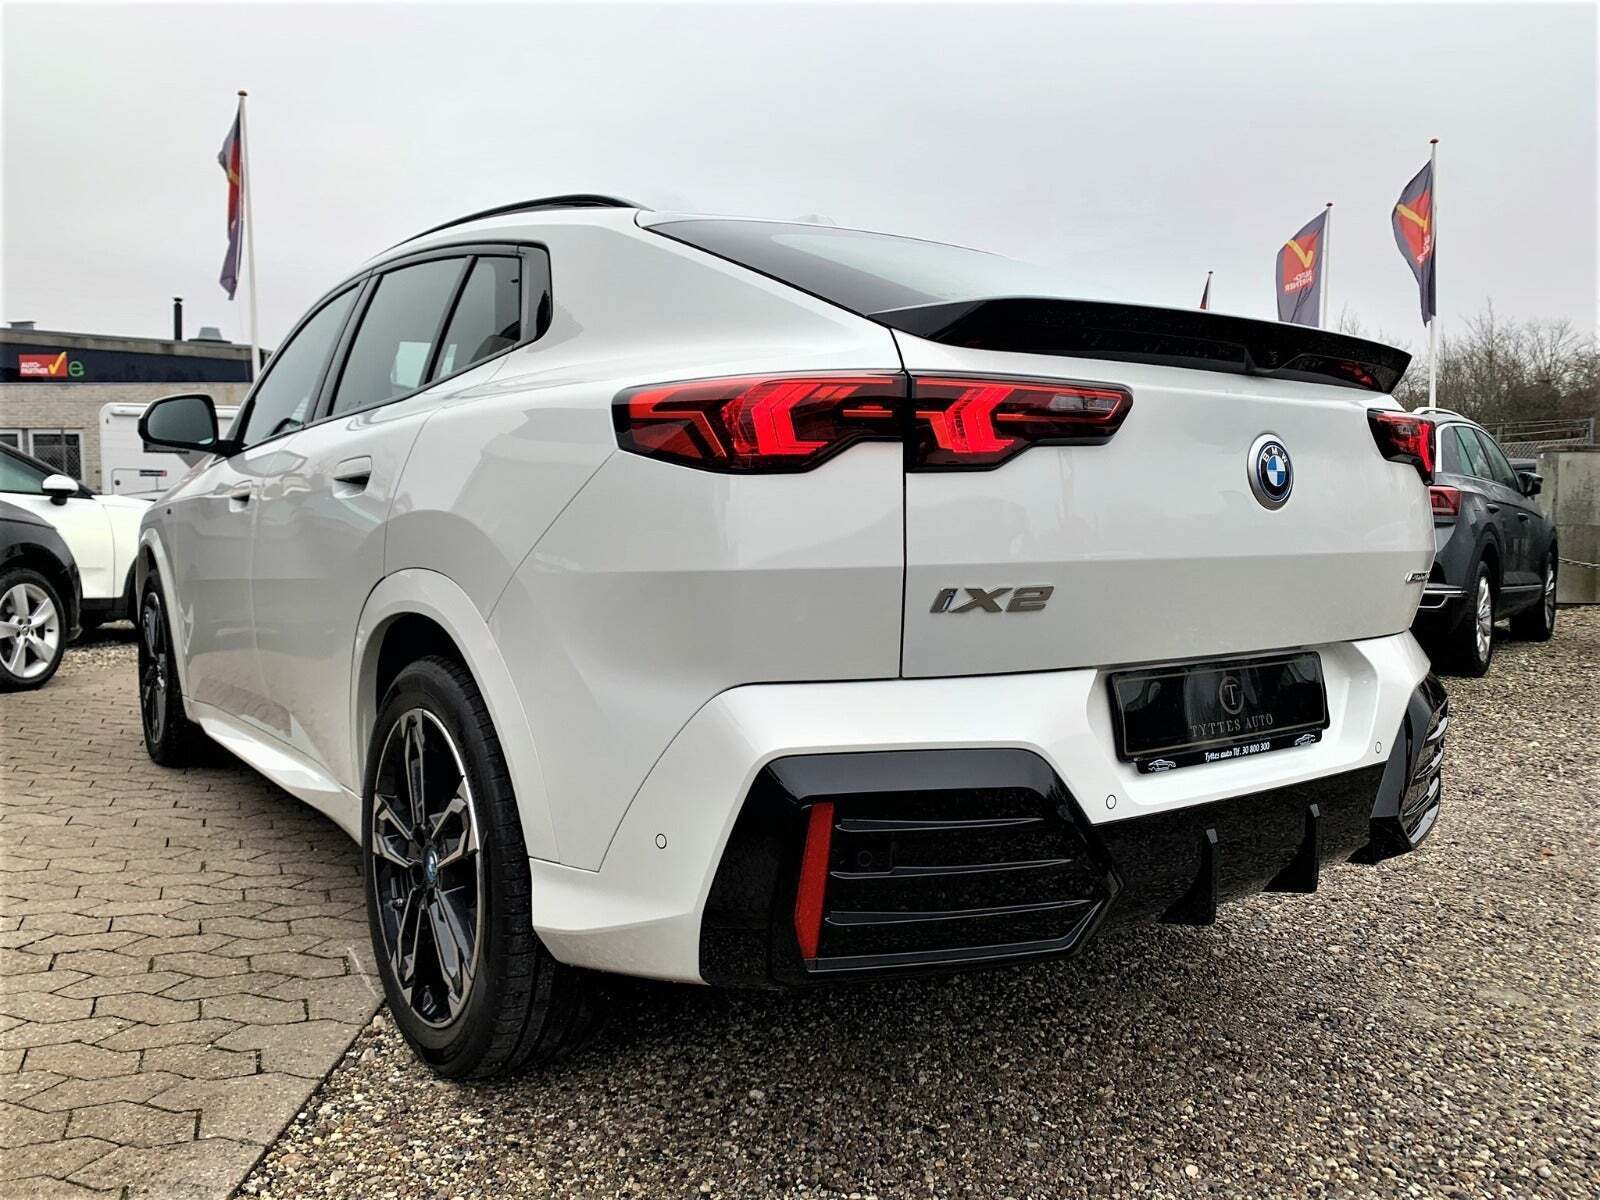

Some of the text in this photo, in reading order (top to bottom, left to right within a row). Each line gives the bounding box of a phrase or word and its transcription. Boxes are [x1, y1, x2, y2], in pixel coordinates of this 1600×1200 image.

[1262, 447, 1288, 463] BMW
[929, 585, 1055, 613] iX2
[1191, 713, 1273, 737] TYTTES AUTO
[1205, 751, 1220, 763] Tyttes
[1220, 750, 1232, 758] auto
[1242, 745, 1249, 755] 30
[1249, 743, 1260, 753] 800
[1260, 741, 1270, 752] 300
